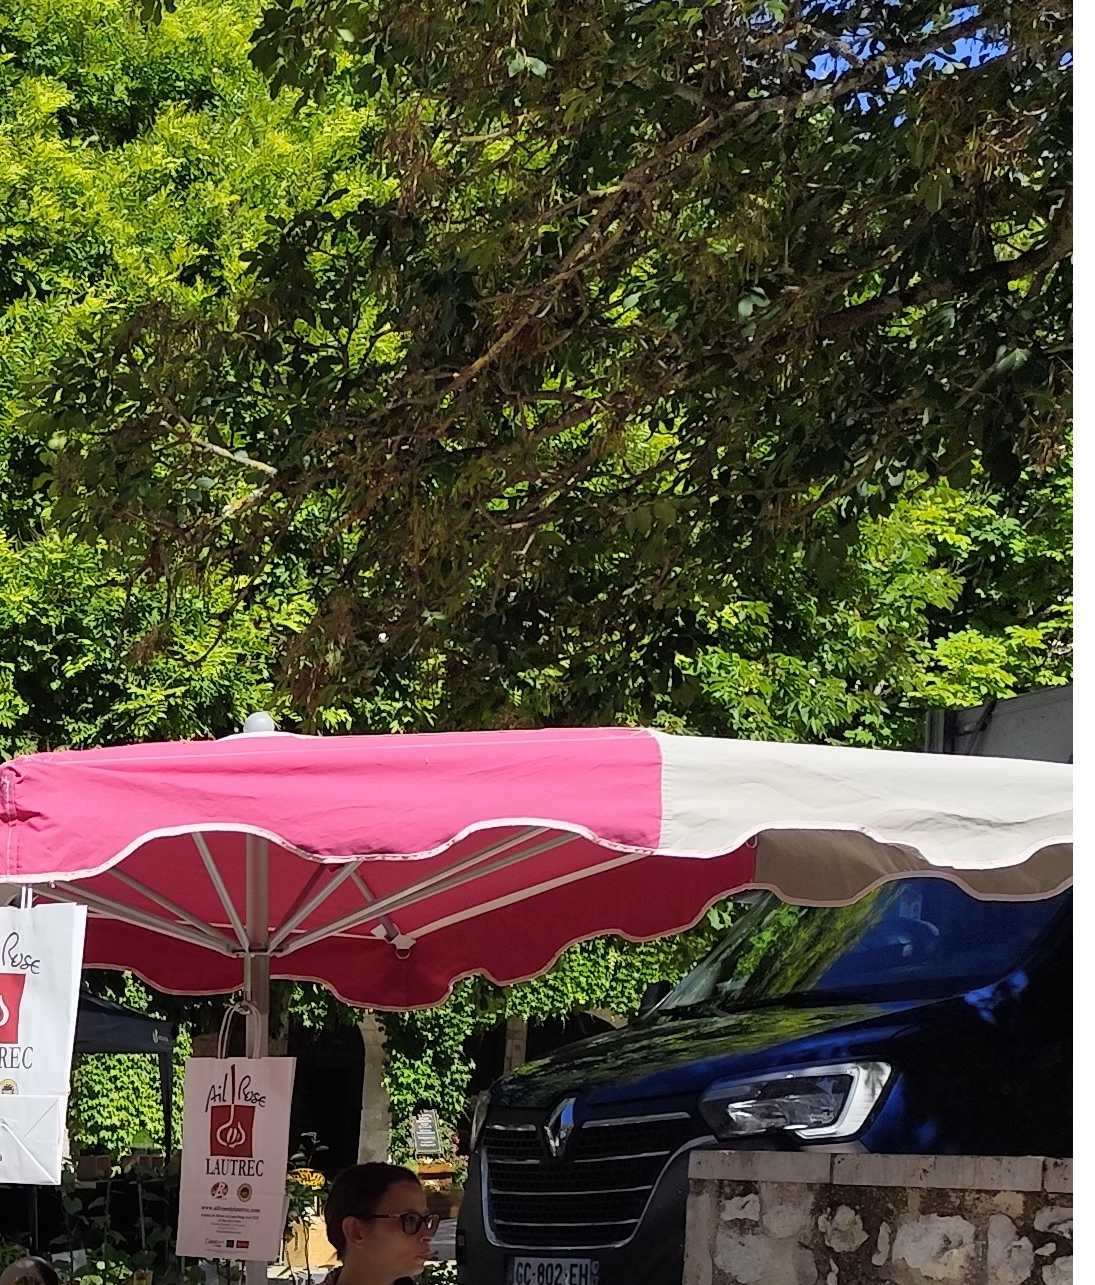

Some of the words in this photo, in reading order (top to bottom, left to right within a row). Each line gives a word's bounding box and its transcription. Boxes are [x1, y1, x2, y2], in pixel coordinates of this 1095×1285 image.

[2, 931, 41, 975] Rose
[205, 1073, 229, 1113] Ail
[238, 1075, 267, 1108] Rose
[205, 1158, 265, 1177] LAUTREC
